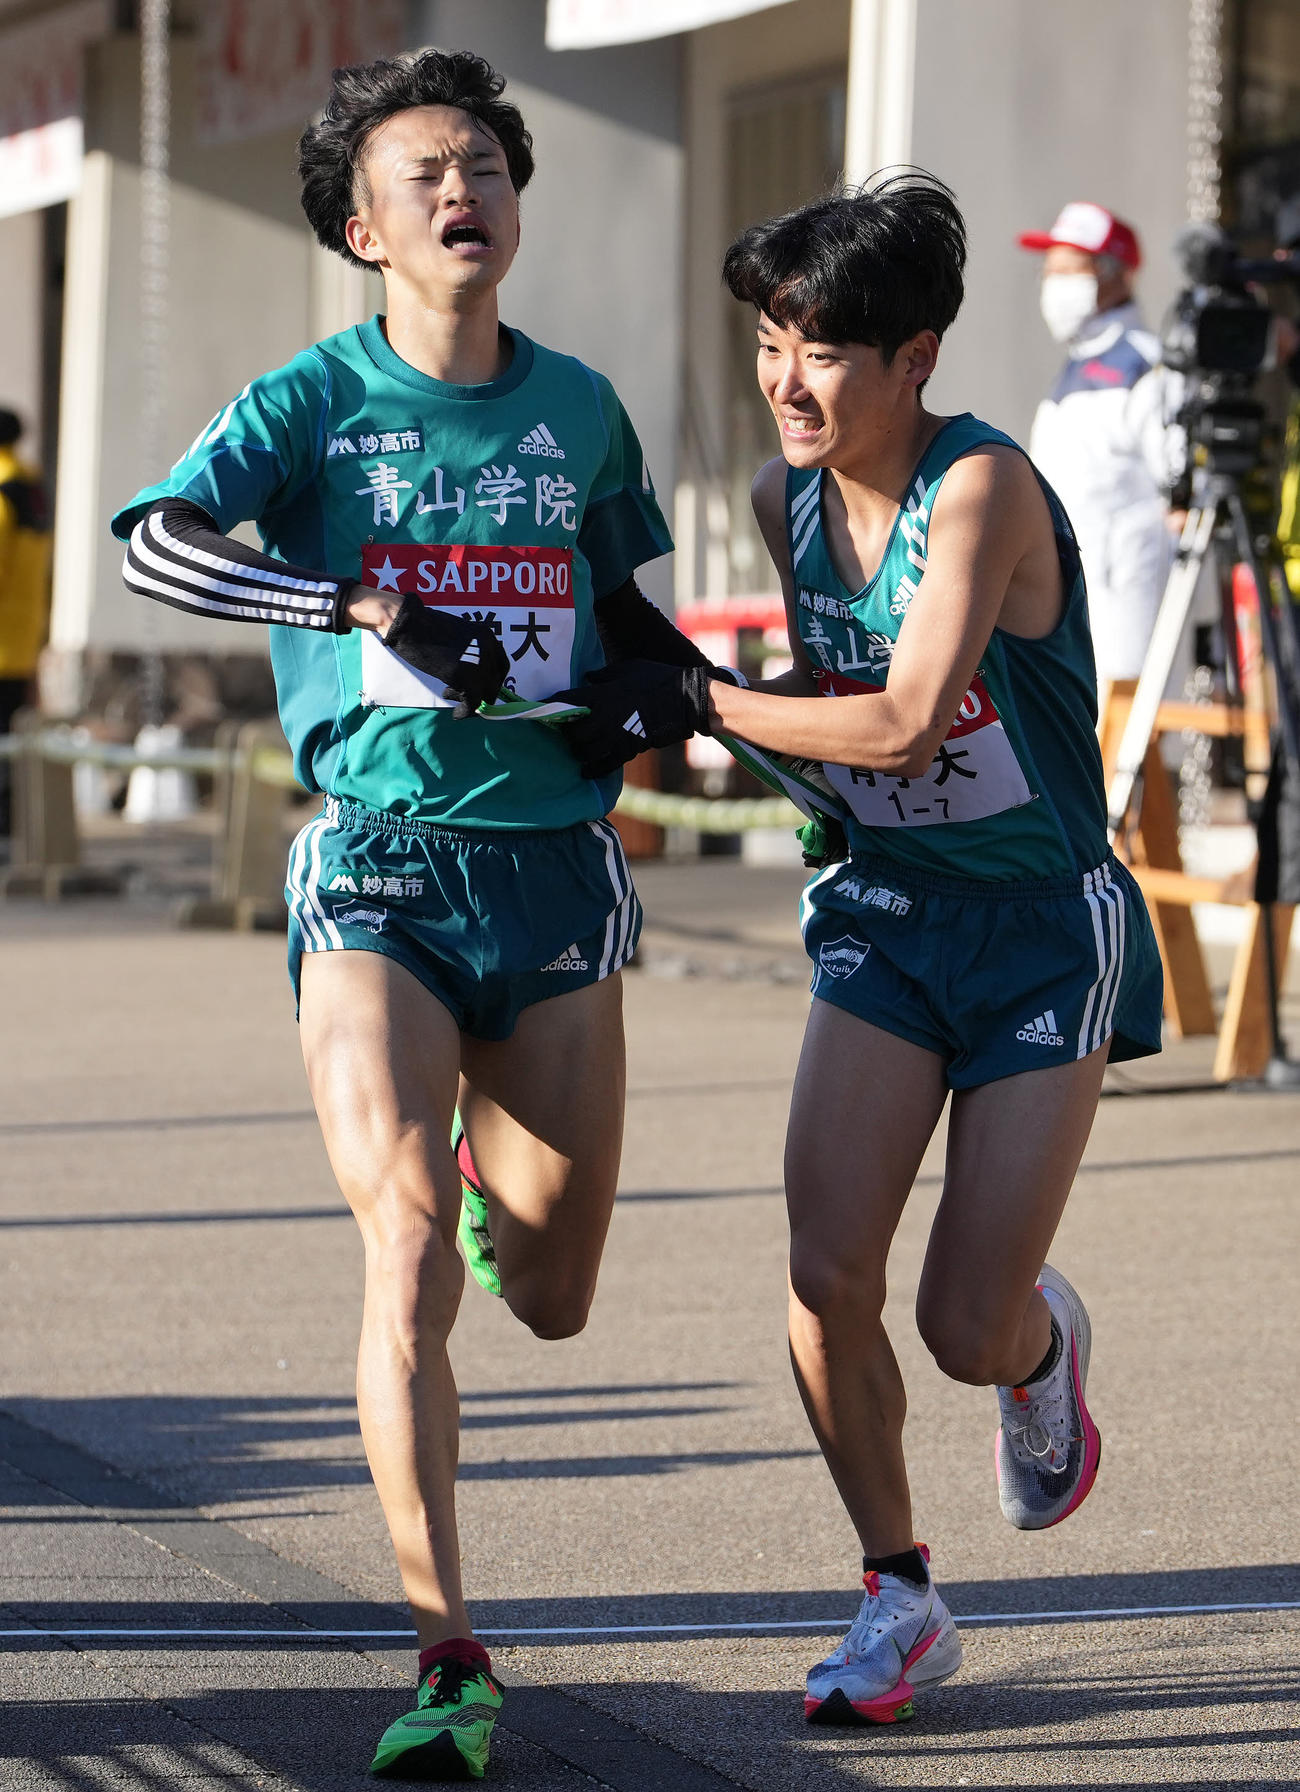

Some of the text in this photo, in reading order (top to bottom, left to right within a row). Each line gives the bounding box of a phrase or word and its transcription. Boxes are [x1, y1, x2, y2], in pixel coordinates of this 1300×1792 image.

[358, 430, 421, 455] 妙高市
[517, 442, 566, 460] adidas
[355, 462, 577, 531] 青山学院
[416, 560, 568, 596] SAPPORO
[362, 874, 425, 897] 妙高市
[1016, 1028, 1064, 1046] adidas
